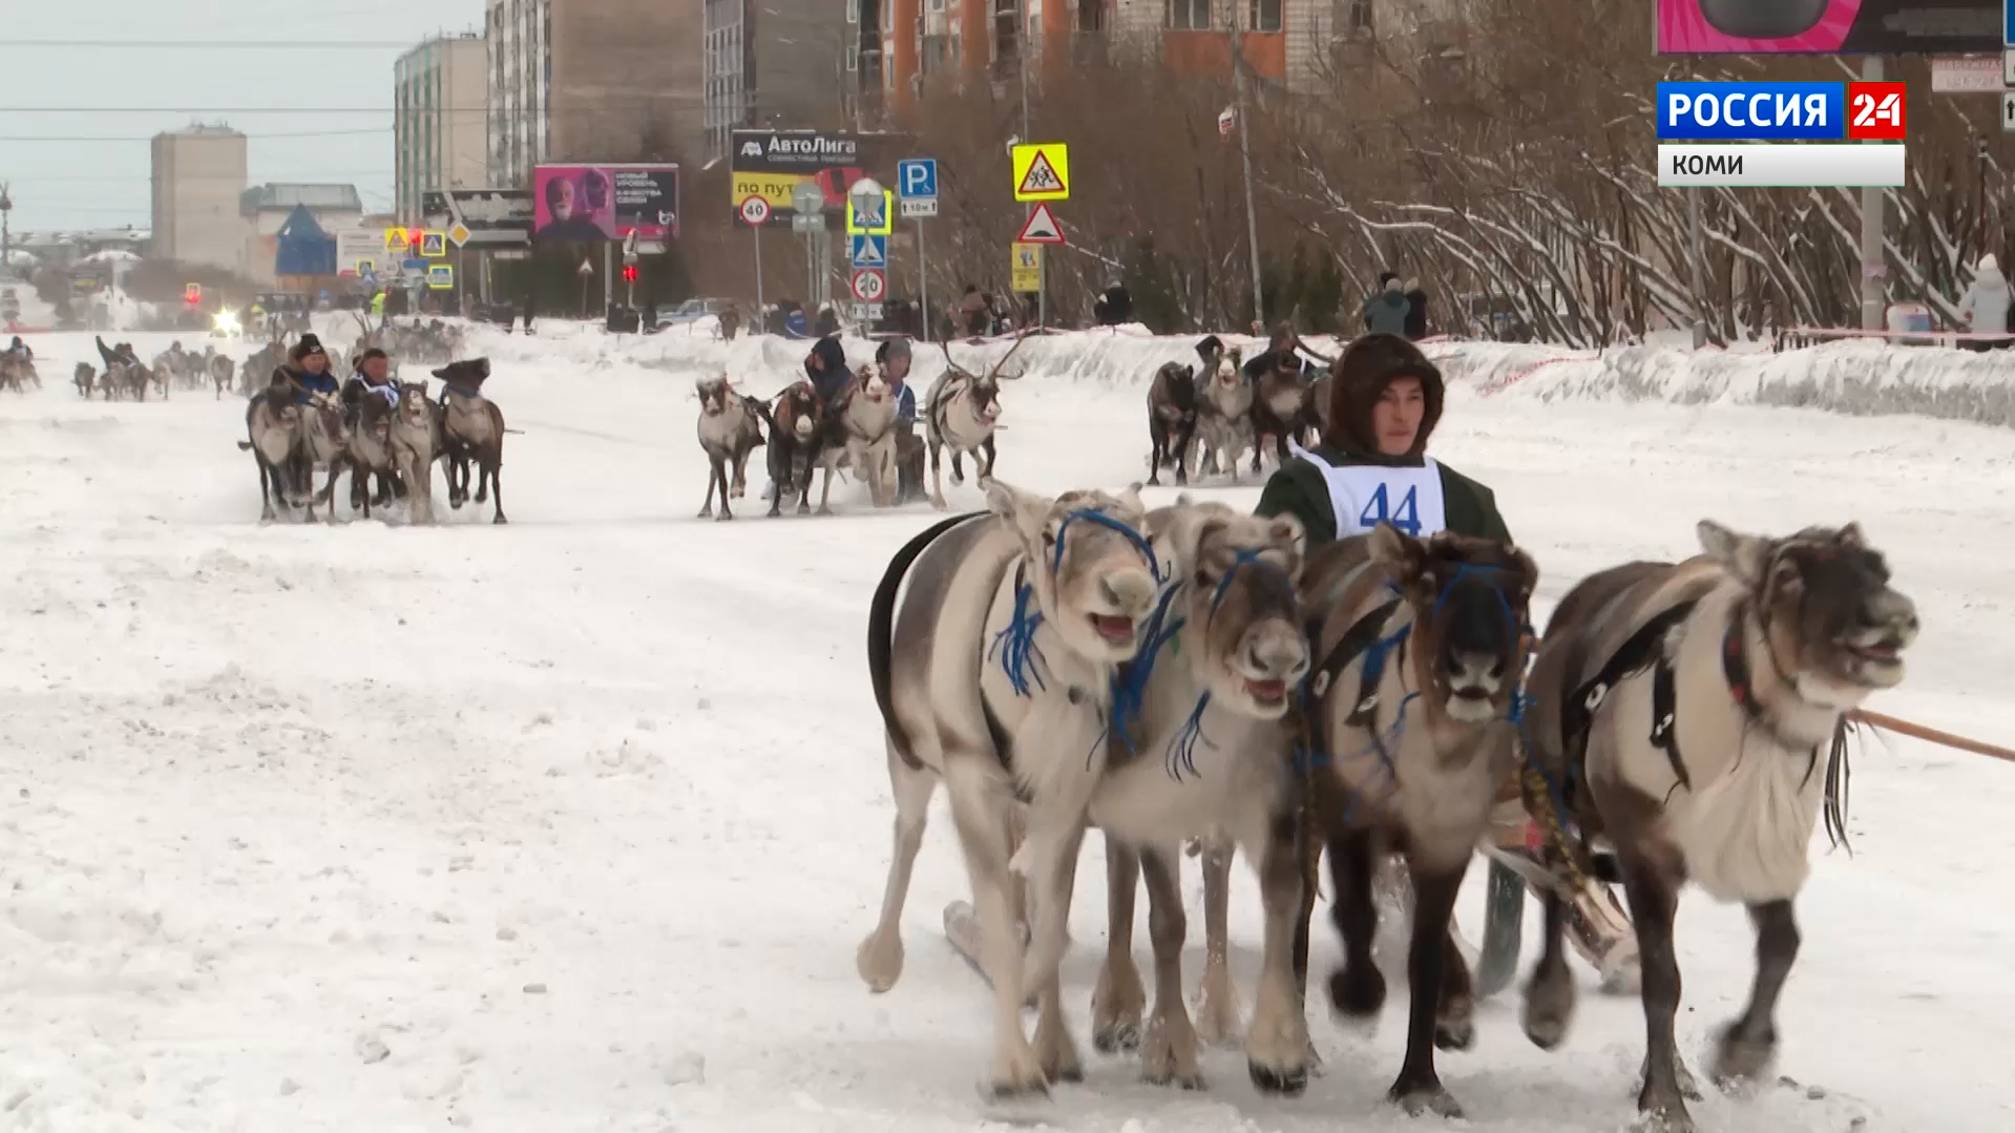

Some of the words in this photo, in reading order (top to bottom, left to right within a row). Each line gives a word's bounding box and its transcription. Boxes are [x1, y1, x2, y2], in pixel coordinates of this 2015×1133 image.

[768, 135, 856, 154] АвтоЛига
[907, 165, 928, 193] P
[737, 183, 759, 193] по
[764, 183, 794, 198] пут
[746, 204, 764, 215] 40
[860, 278, 878, 292] 20
[1360, 482, 1423, 538] 44
